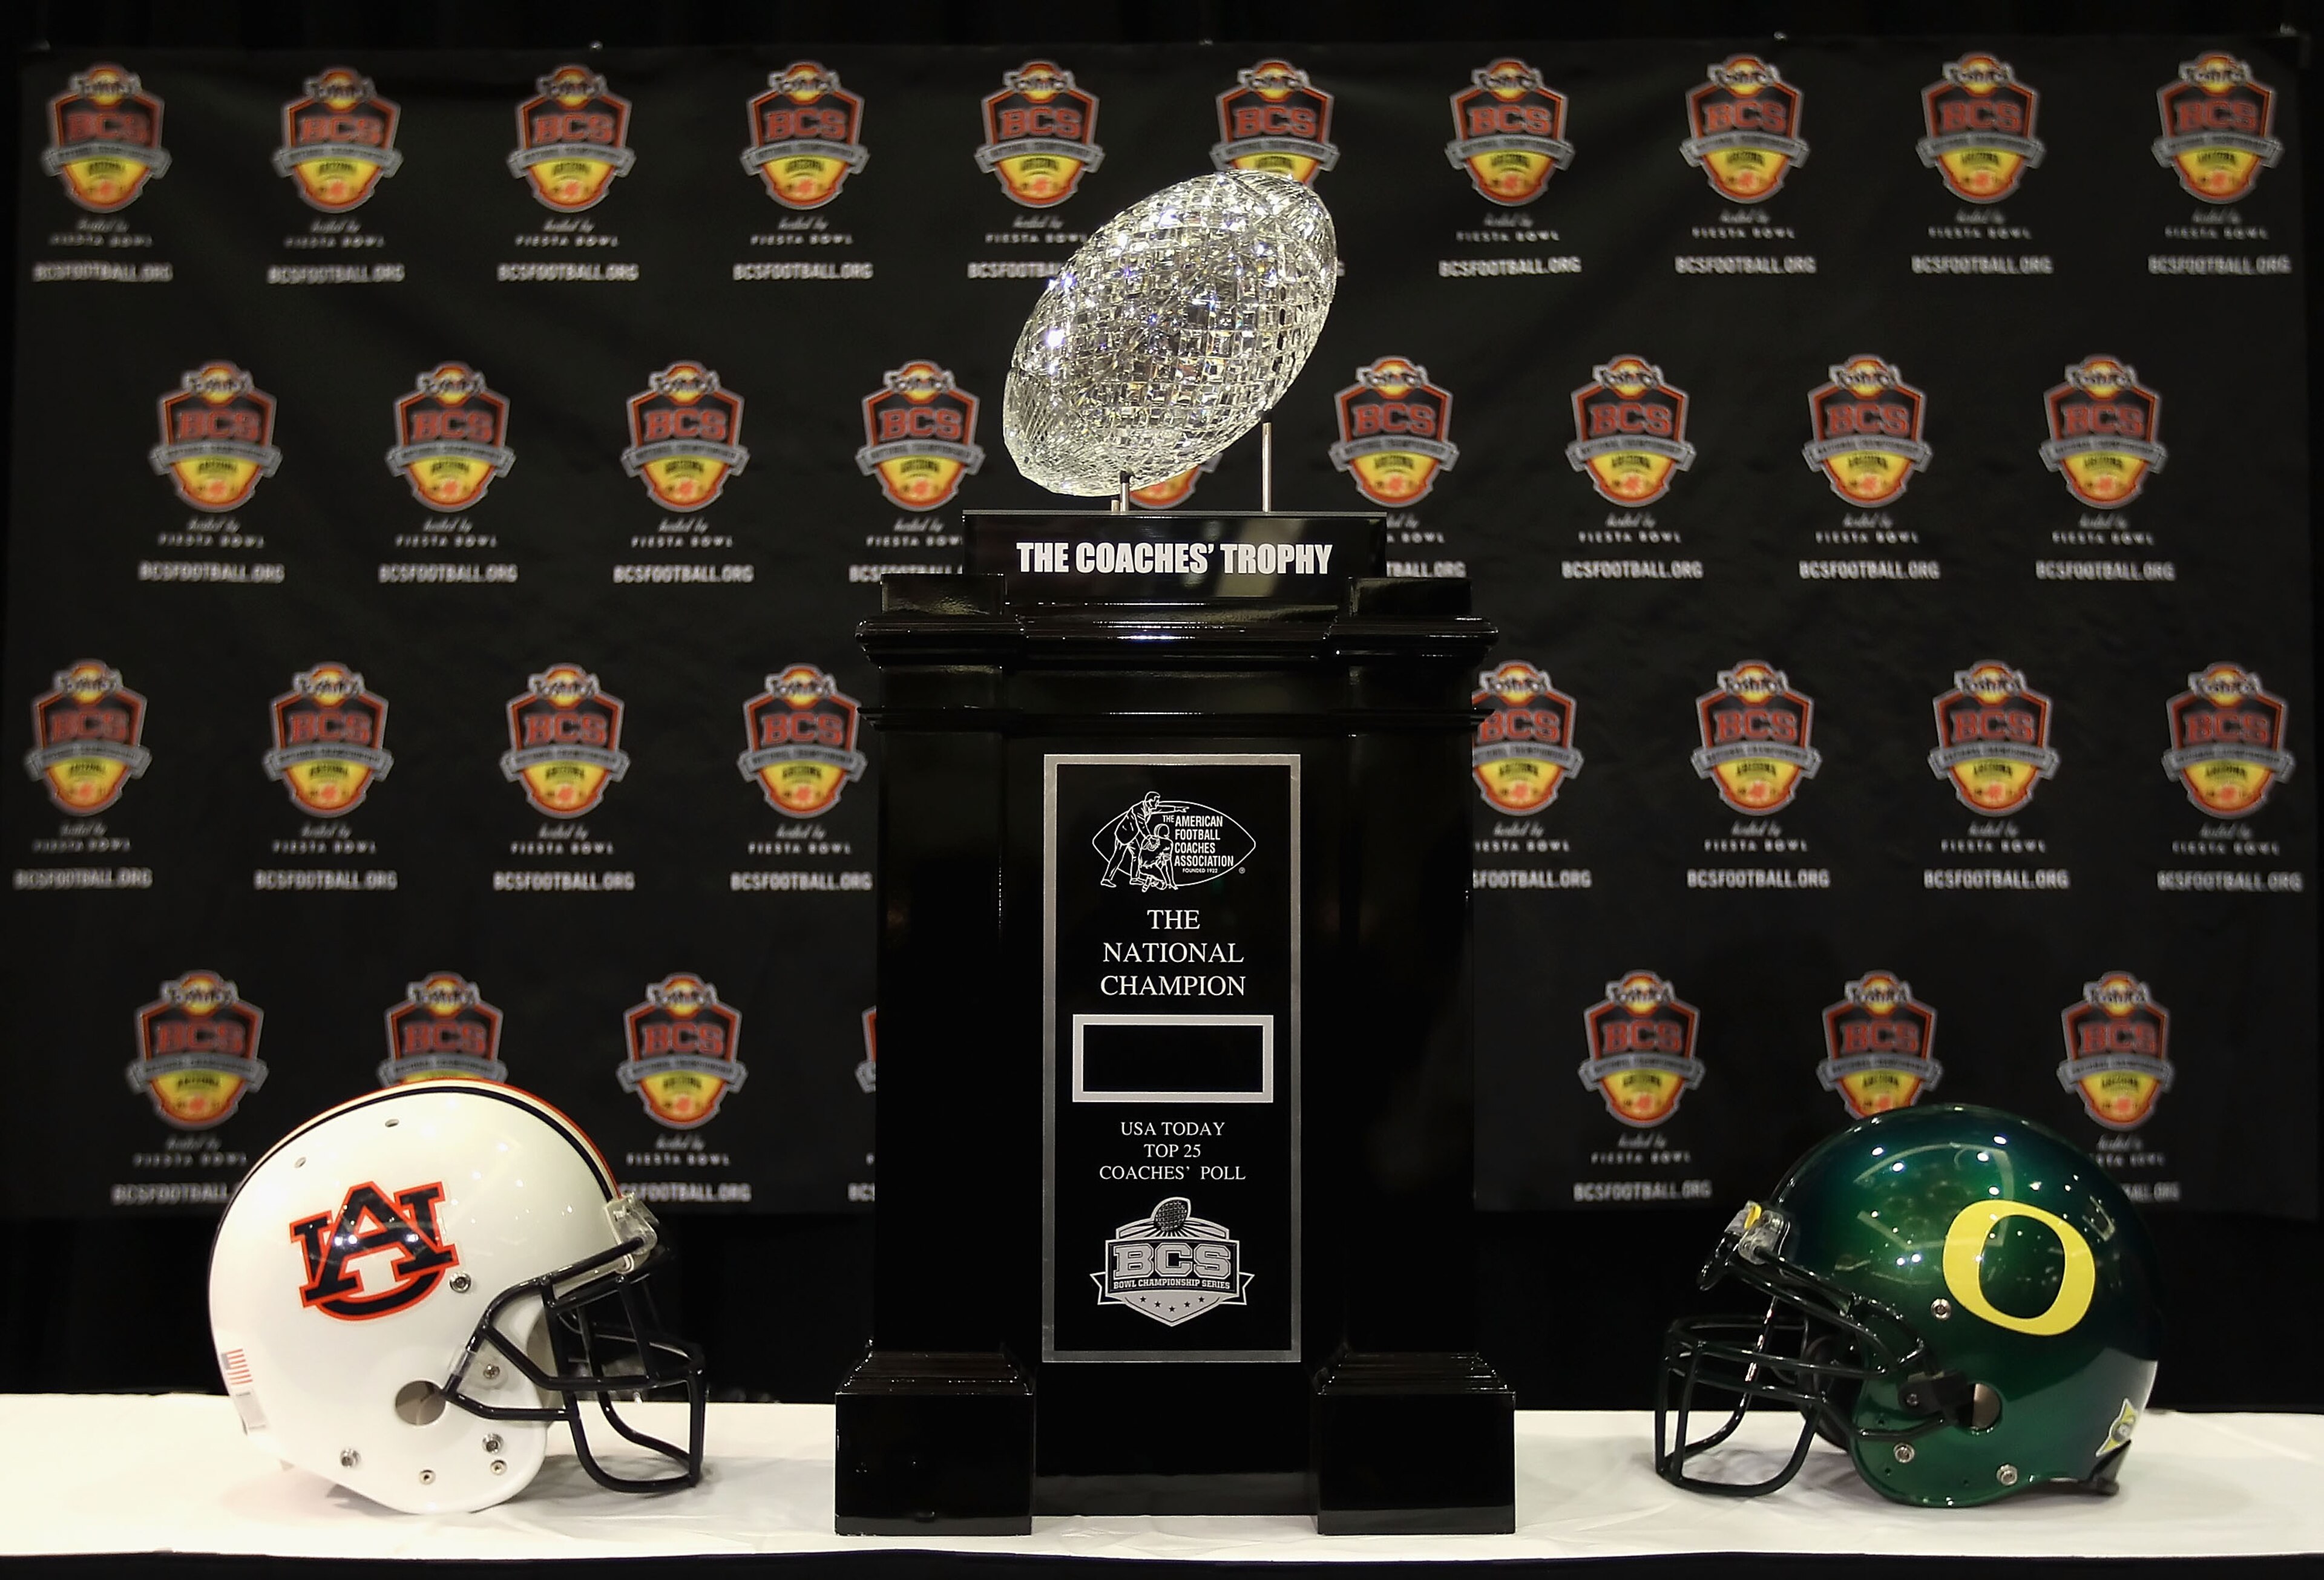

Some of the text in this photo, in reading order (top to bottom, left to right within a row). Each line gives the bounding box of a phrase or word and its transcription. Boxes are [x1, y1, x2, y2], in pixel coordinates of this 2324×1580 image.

[65, 112, 151, 144] BCS
[297, 114, 384, 145] BCS
[533, 112, 614, 143] BCS
[765, 108, 847, 141] BCS
[1000, 107, 1082, 139] BCS
[1235, 107, 1316, 137] BCS
[1468, 104, 1552, 135] BCS
[1704, 100, 1786, 133] BCS
[1939, 99, 2021, 133] BCS
[2177, 100, 2259, 132] BCS
[497, 263, 639, 281] BCSFOOTBALL.ORG
[733, 263, 873, 280] BCSFOOTBALL.ORG
[1439, 257, 1581, 277] BCSFOOTBALL.ORG
[1675, 256, 1816, 274] BCSFOOTBALL.ORG
[177, 408, 260, 441] BCS
[412, 410, 495, 441] BCS
[643, 407, 727, 439] BCS
[879, 407, 962, 439] BCS
[1353, 402, 1436, 435] BCS
[1589, 402, 1672, 435] BCS
[1827, 402, 1909, 436] BCS
[2062, 402, 2145, 436] BCS
[139, 563, 285, 582] BCSFOOTBALL.ORG
[379, 564, 518, 582] BCSFOOTBALL.ORG
[613, 565, 754, 583] BCSFOOTBALL.ORG
[1017, 543, 1069, 572] THE
[1220, 543, 1333, 574] TROPHY
[1561, 560, 1703, 579] BCSFOOTBALL.ORG
[1799, 561, 1940, 579] BCSFOOTBALL.ORG
[2035, 562, 2175, 580] BCSFOOTBALL.ORG
[49, 709, 130, 742] BCS
[288, 710, 370, 744] BCS
[524, 712, 607, 746] BCS
[761, 712, 842, 746] BCS
[1480, 709, 1560, 742] BCS
[1715, 709, 1796, 742] BCS
[1951, 709, 2034, 742] BCS
[2185, 710, 2268, 744] BCS
[1175, 815, 1223, 827] AMERICAN
[1175, 829, 1220, 840] FOOTBALL
[1174, 855, 1234, 867] ASSOCIATION
[1175, 842, 1215, 853] COACHES
[1474, 840, 1519, 852] IESTA
[254, 871, 398, 890] BCSFOOTBALL.ORG
[493, 872, 635, 890] BCSFOOTBALL.ORG
[730, 872, 873, 890] BCSFOOTBALL.ORG
[1472, 870, 1592, 888] SFOOTBALL.ORG
[1687, 870, 1831, 888] BCSFOOTBALL.ORG
[1923, 870, 2070, 888] BCSFOOTBALL.ORG
[2157, 871, 2303, 890] BCSFOOTBALL.ORG
[1147, 910, 1200, 929] THE
[1103, 943, 1244, 962] NATIONAL
[1101, 975, 1246, 995] CHAMPION
[154, 1020, 245, 1054] BCS
[402, 1021, 486, 1055] BCS
[642, 1021, 725, 1056] BCS
[1602, 1019, 1682, 1053] BCS
[1842, 1019, 1919, 1053] BCS
[2079, 1020, 2156, 1054] BCS
[1121, 1122, 1224, 1135] USA TODAY
[1144, 1144, 1200, 1157] TOP 25
[1201, 1166, 1246, 1179] POLL
[1573, 1181, 1712, 1201] BCSFOOTBALL.ORG
[1114, 1244, 1230, 1279] BCS
[1943, 1200, 2095, 1336] O
[1114, 1279, 1230, 1289] BOWL CHAMPIONSHIP SERIES
